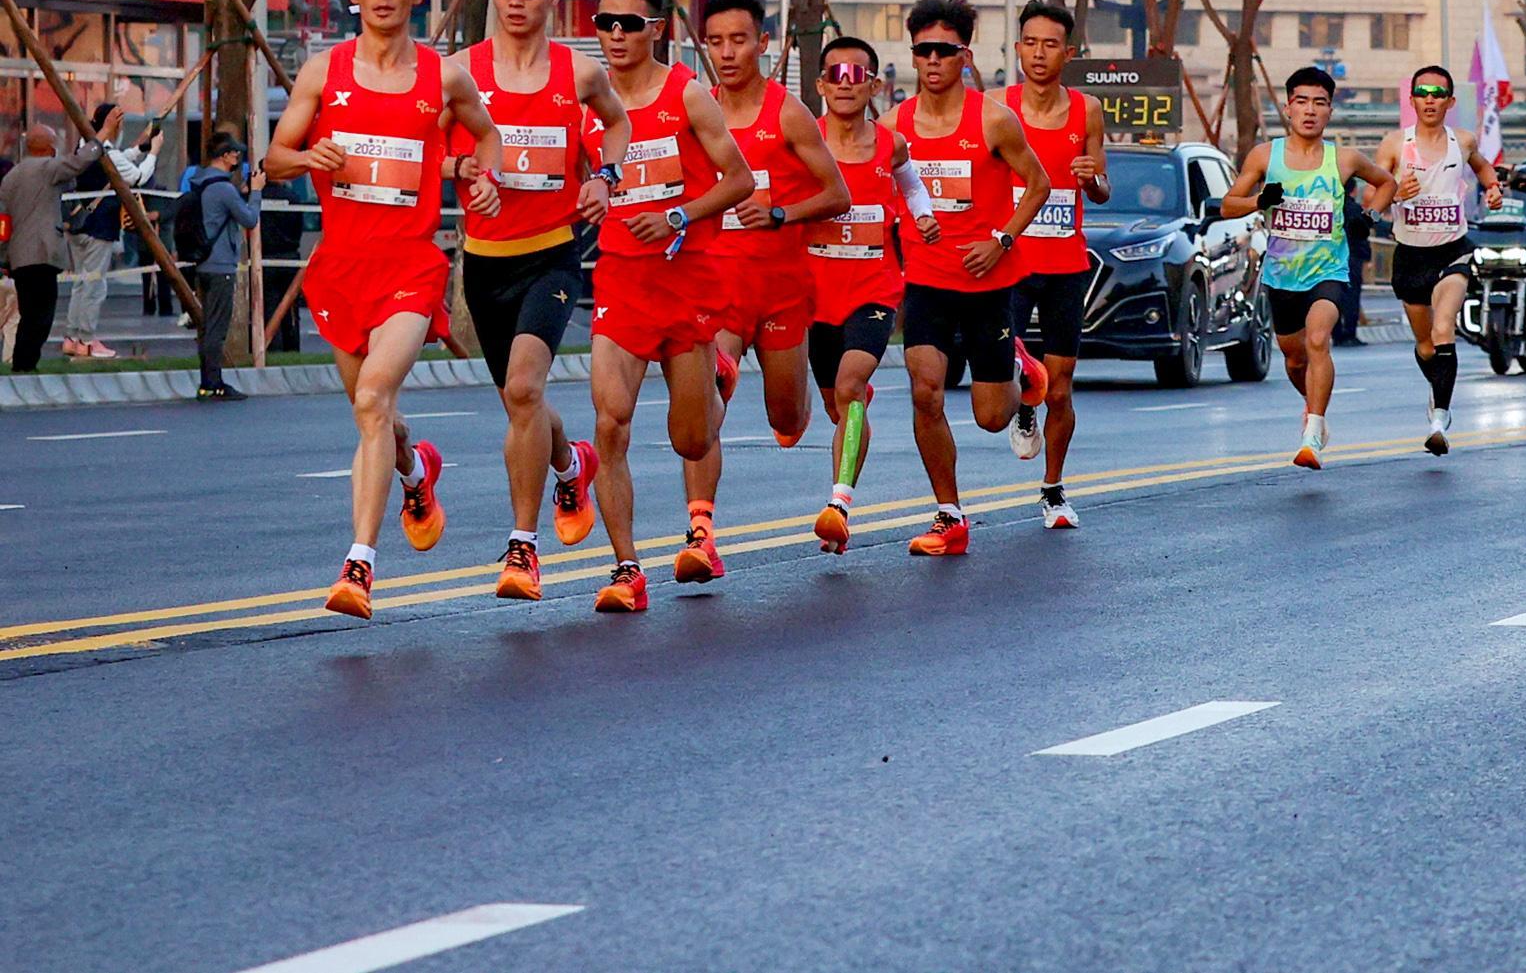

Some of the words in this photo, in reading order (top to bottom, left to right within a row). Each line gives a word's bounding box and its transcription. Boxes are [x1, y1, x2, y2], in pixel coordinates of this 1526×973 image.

[1085, 72, 1139, 84] SUUNTO
[1103, 95, 1172, 125] 4:32
[504, 134, 530, 145] 2023
[354, 142, 382, 156] 2023
[516, 149, 530, 172] 6
[369, 160, 379, 184] 1
[920, 167, 940, 176] 2023
[931, 178, 943, 197] 8
[832, 212, 852, 222] 023
[1031, 206, 1072, 224] 4603
[1274, 210, 1329, 229] A55508
[1407, 207, 1457, 222] A55983
[841, 225, 853, 244] 5
